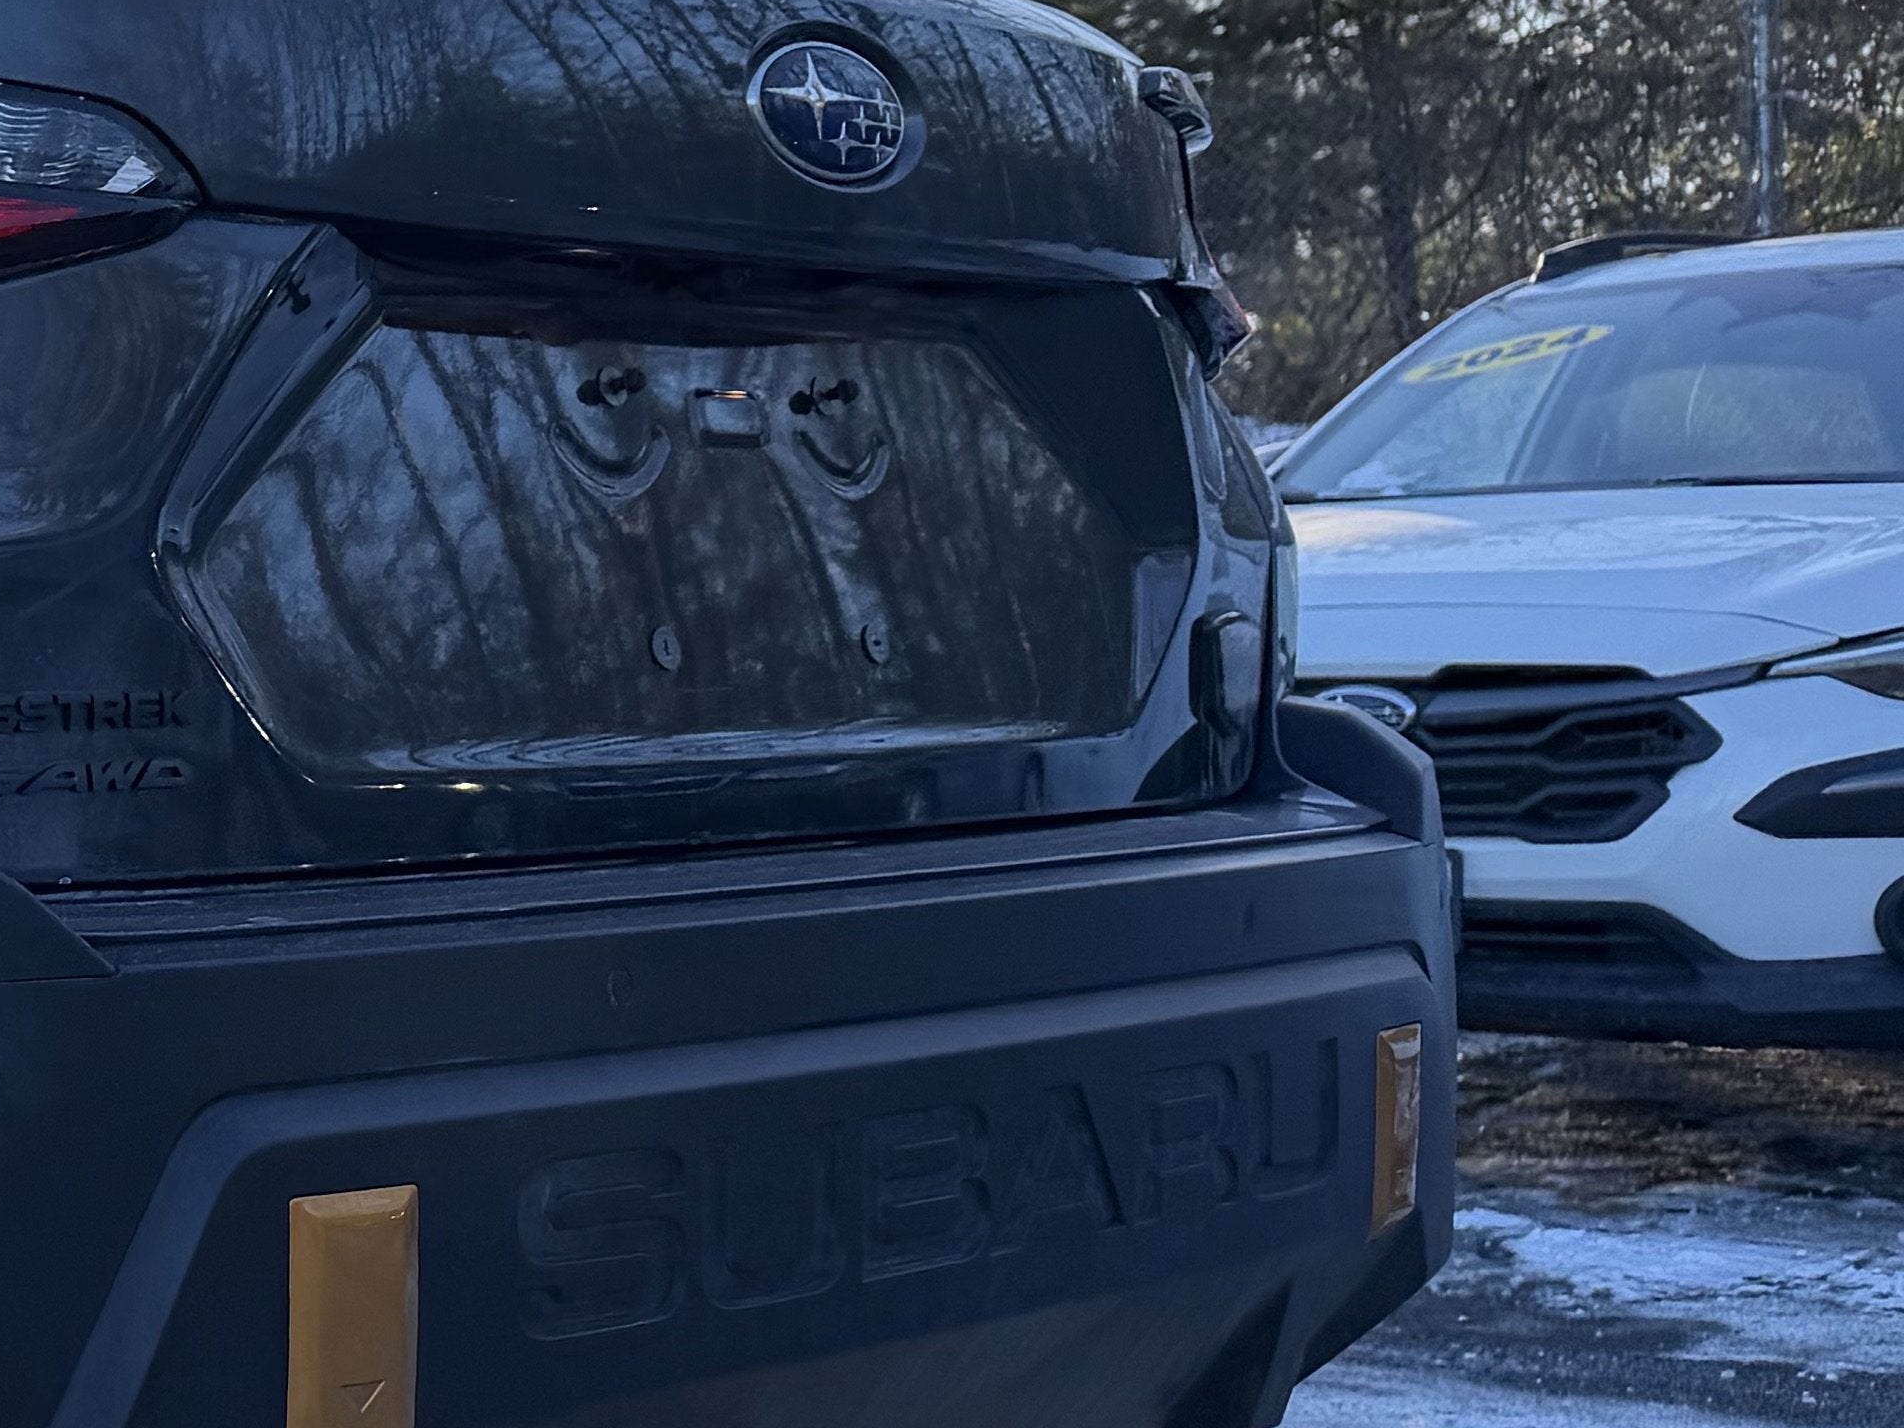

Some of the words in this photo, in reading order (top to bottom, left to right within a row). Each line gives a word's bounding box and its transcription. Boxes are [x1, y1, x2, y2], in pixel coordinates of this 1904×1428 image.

[1426, 328, 1589, 376] 2024
[15, 759, 191, 794] AWD
[518, 1036, 1338, 1340] SUBARU
